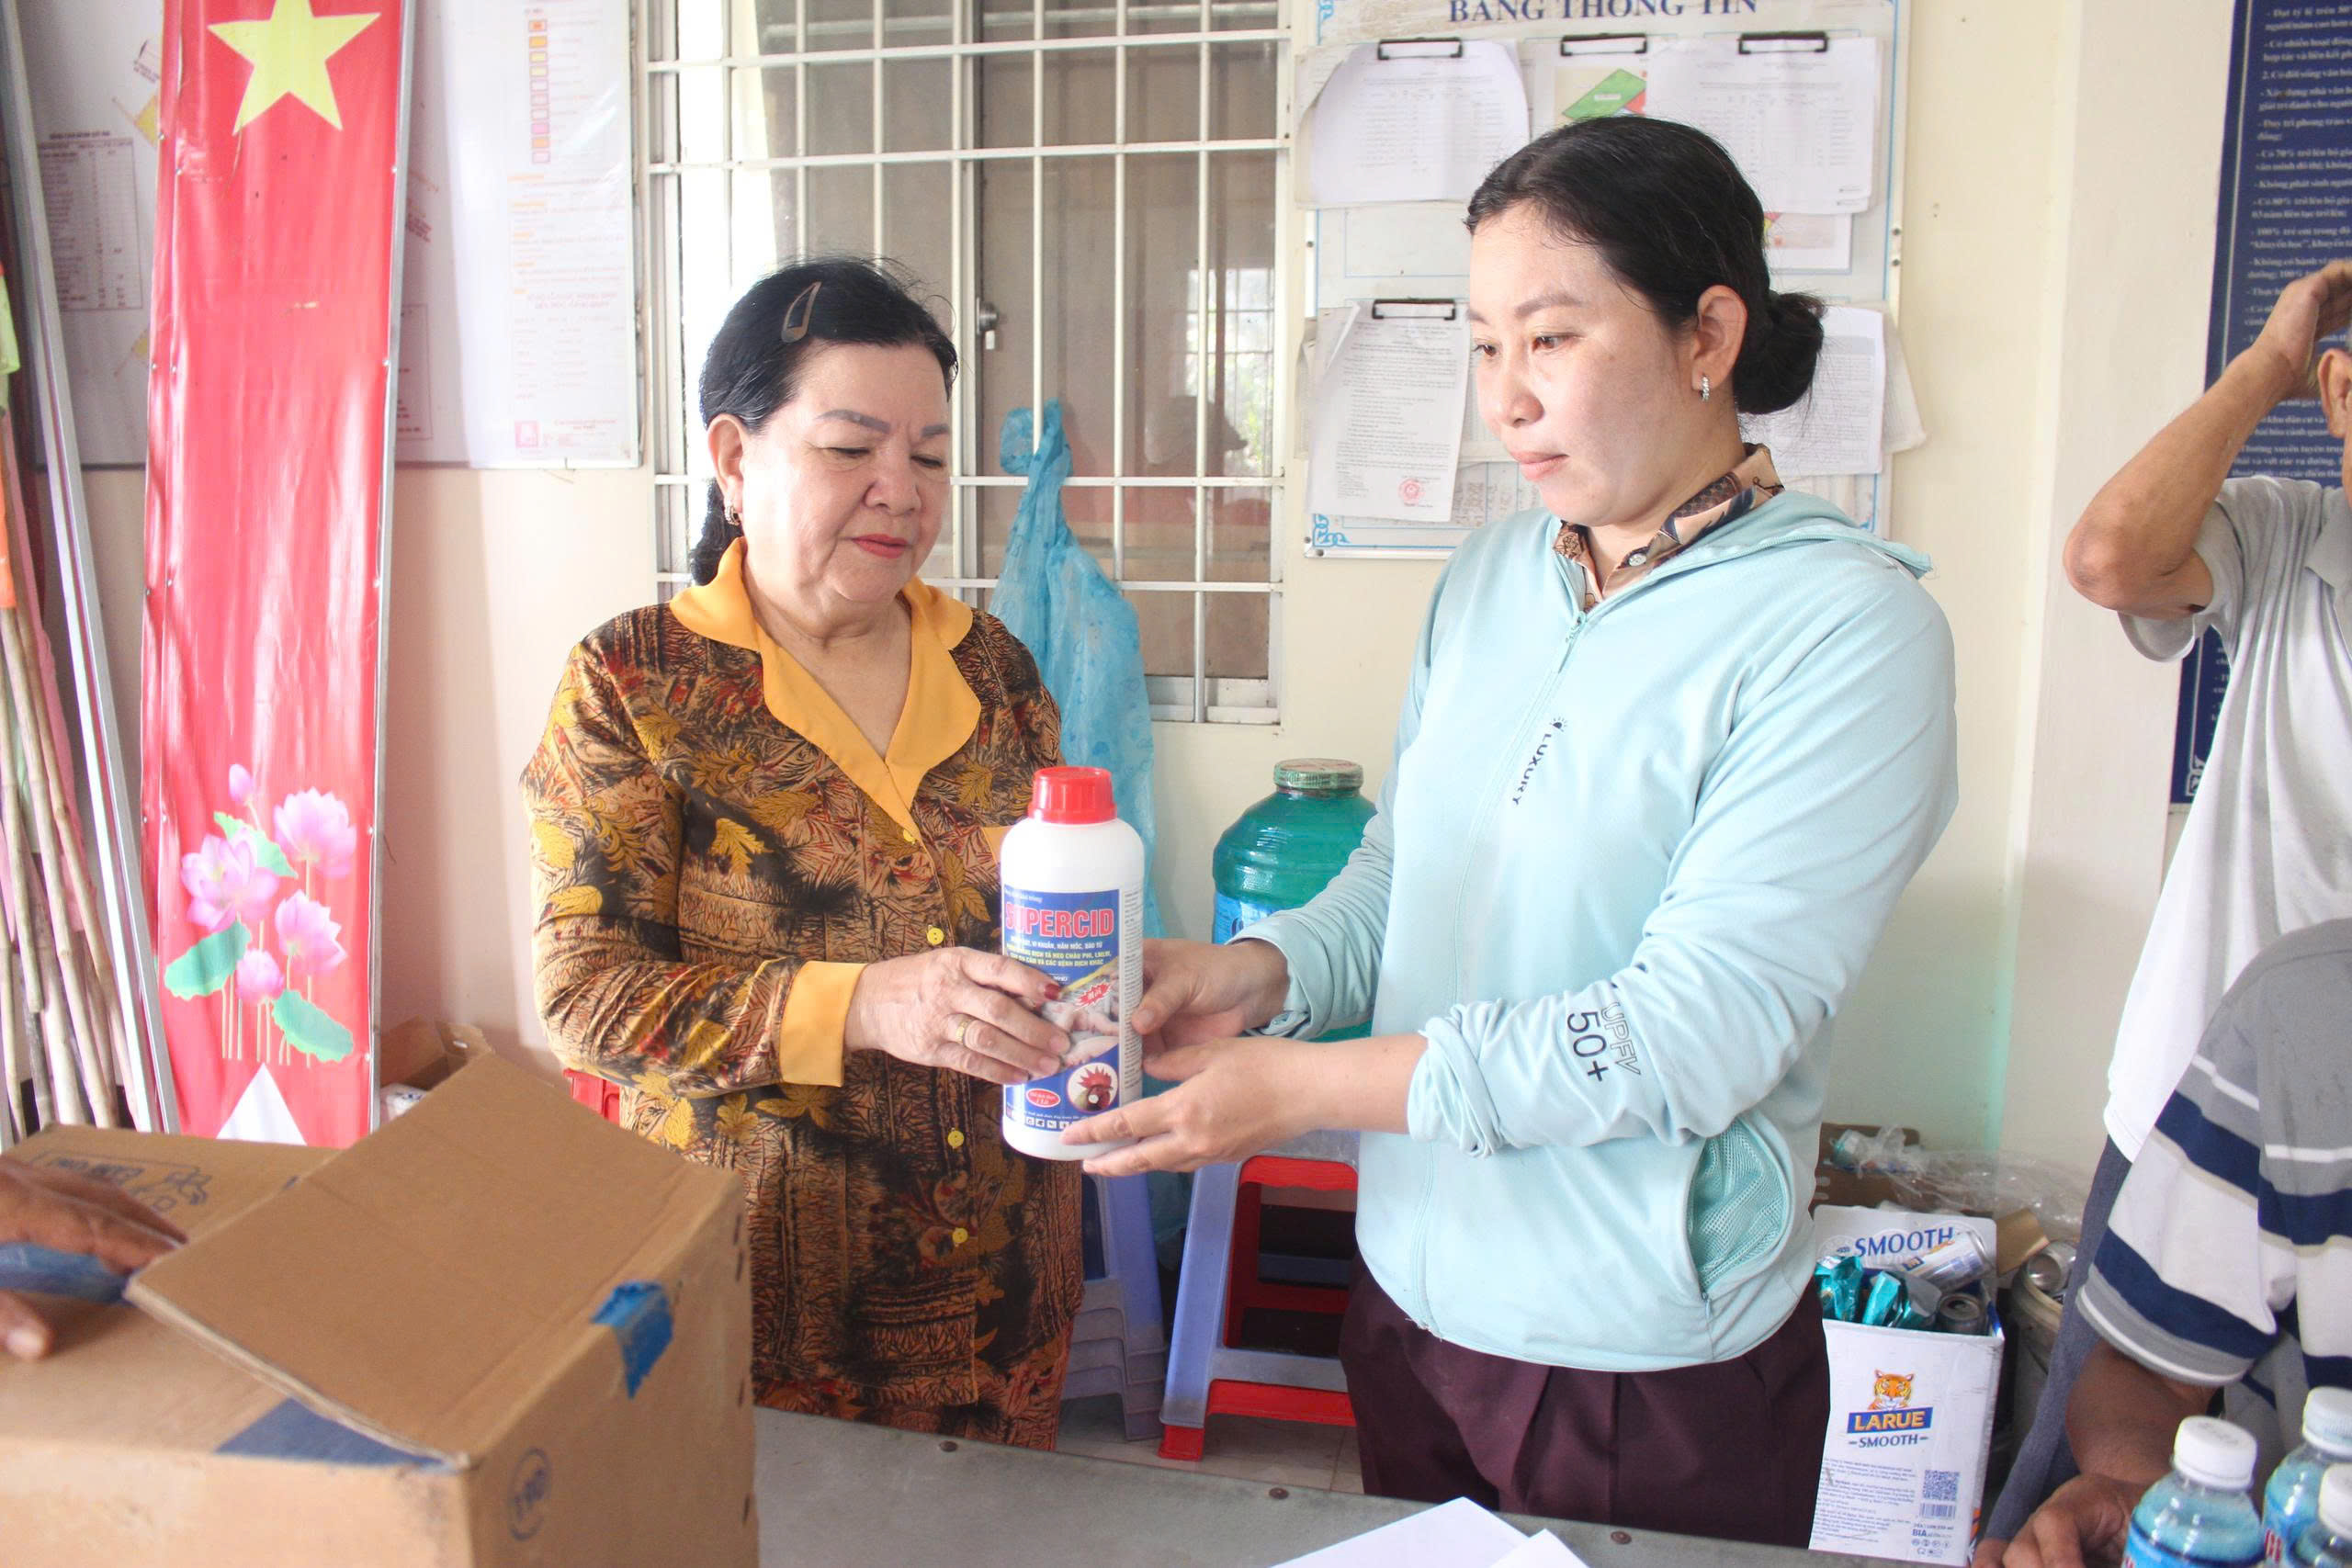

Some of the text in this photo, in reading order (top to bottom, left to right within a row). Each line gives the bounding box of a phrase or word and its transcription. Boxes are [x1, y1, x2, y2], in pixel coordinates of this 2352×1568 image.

[1512, 733, 1552, 805] LUXURY
[1005, 901, 1114, 938] SUPERCID
[1566, 1010, 1610, 1082] 50+
[1854, 1226, 1954, 1258] SMOOTH
[1854, 1411, 1927, 1431] LARUE
[1859, 1434, 1918, 1449] SMOOTH
